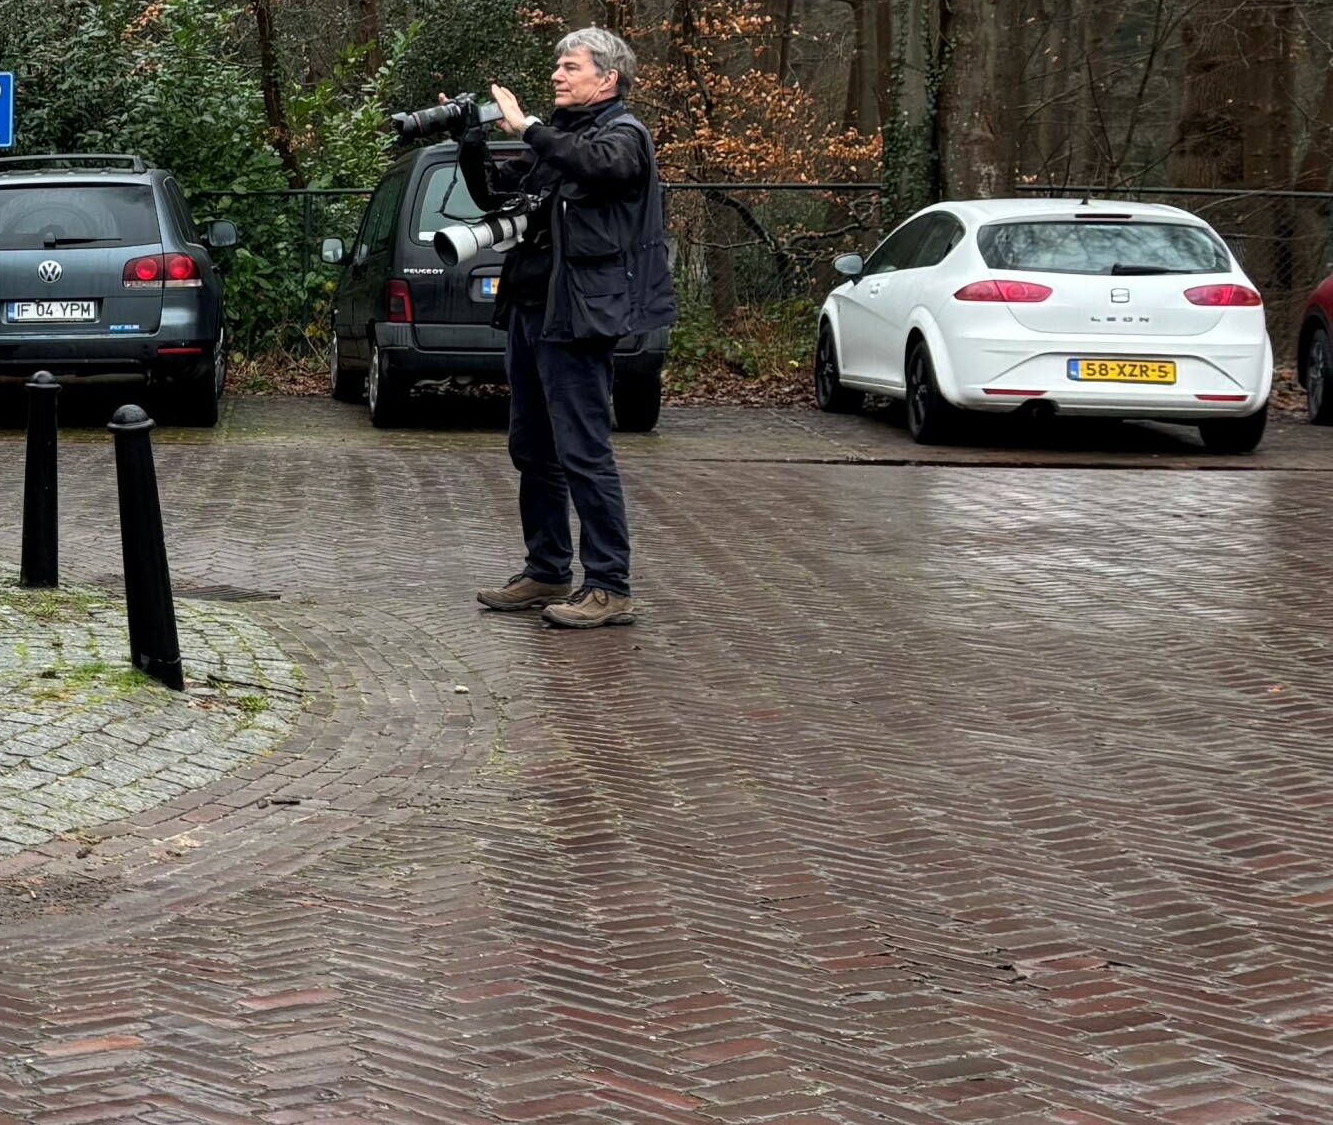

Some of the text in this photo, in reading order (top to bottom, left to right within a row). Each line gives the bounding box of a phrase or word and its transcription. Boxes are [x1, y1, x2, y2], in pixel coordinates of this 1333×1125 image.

[17, 303, 31, 317] IF
[36, 303, 53, 317] 04
[60, 303, 91, 317] YPM
[1086, 363, 1168, 378] 58-XZR-5
